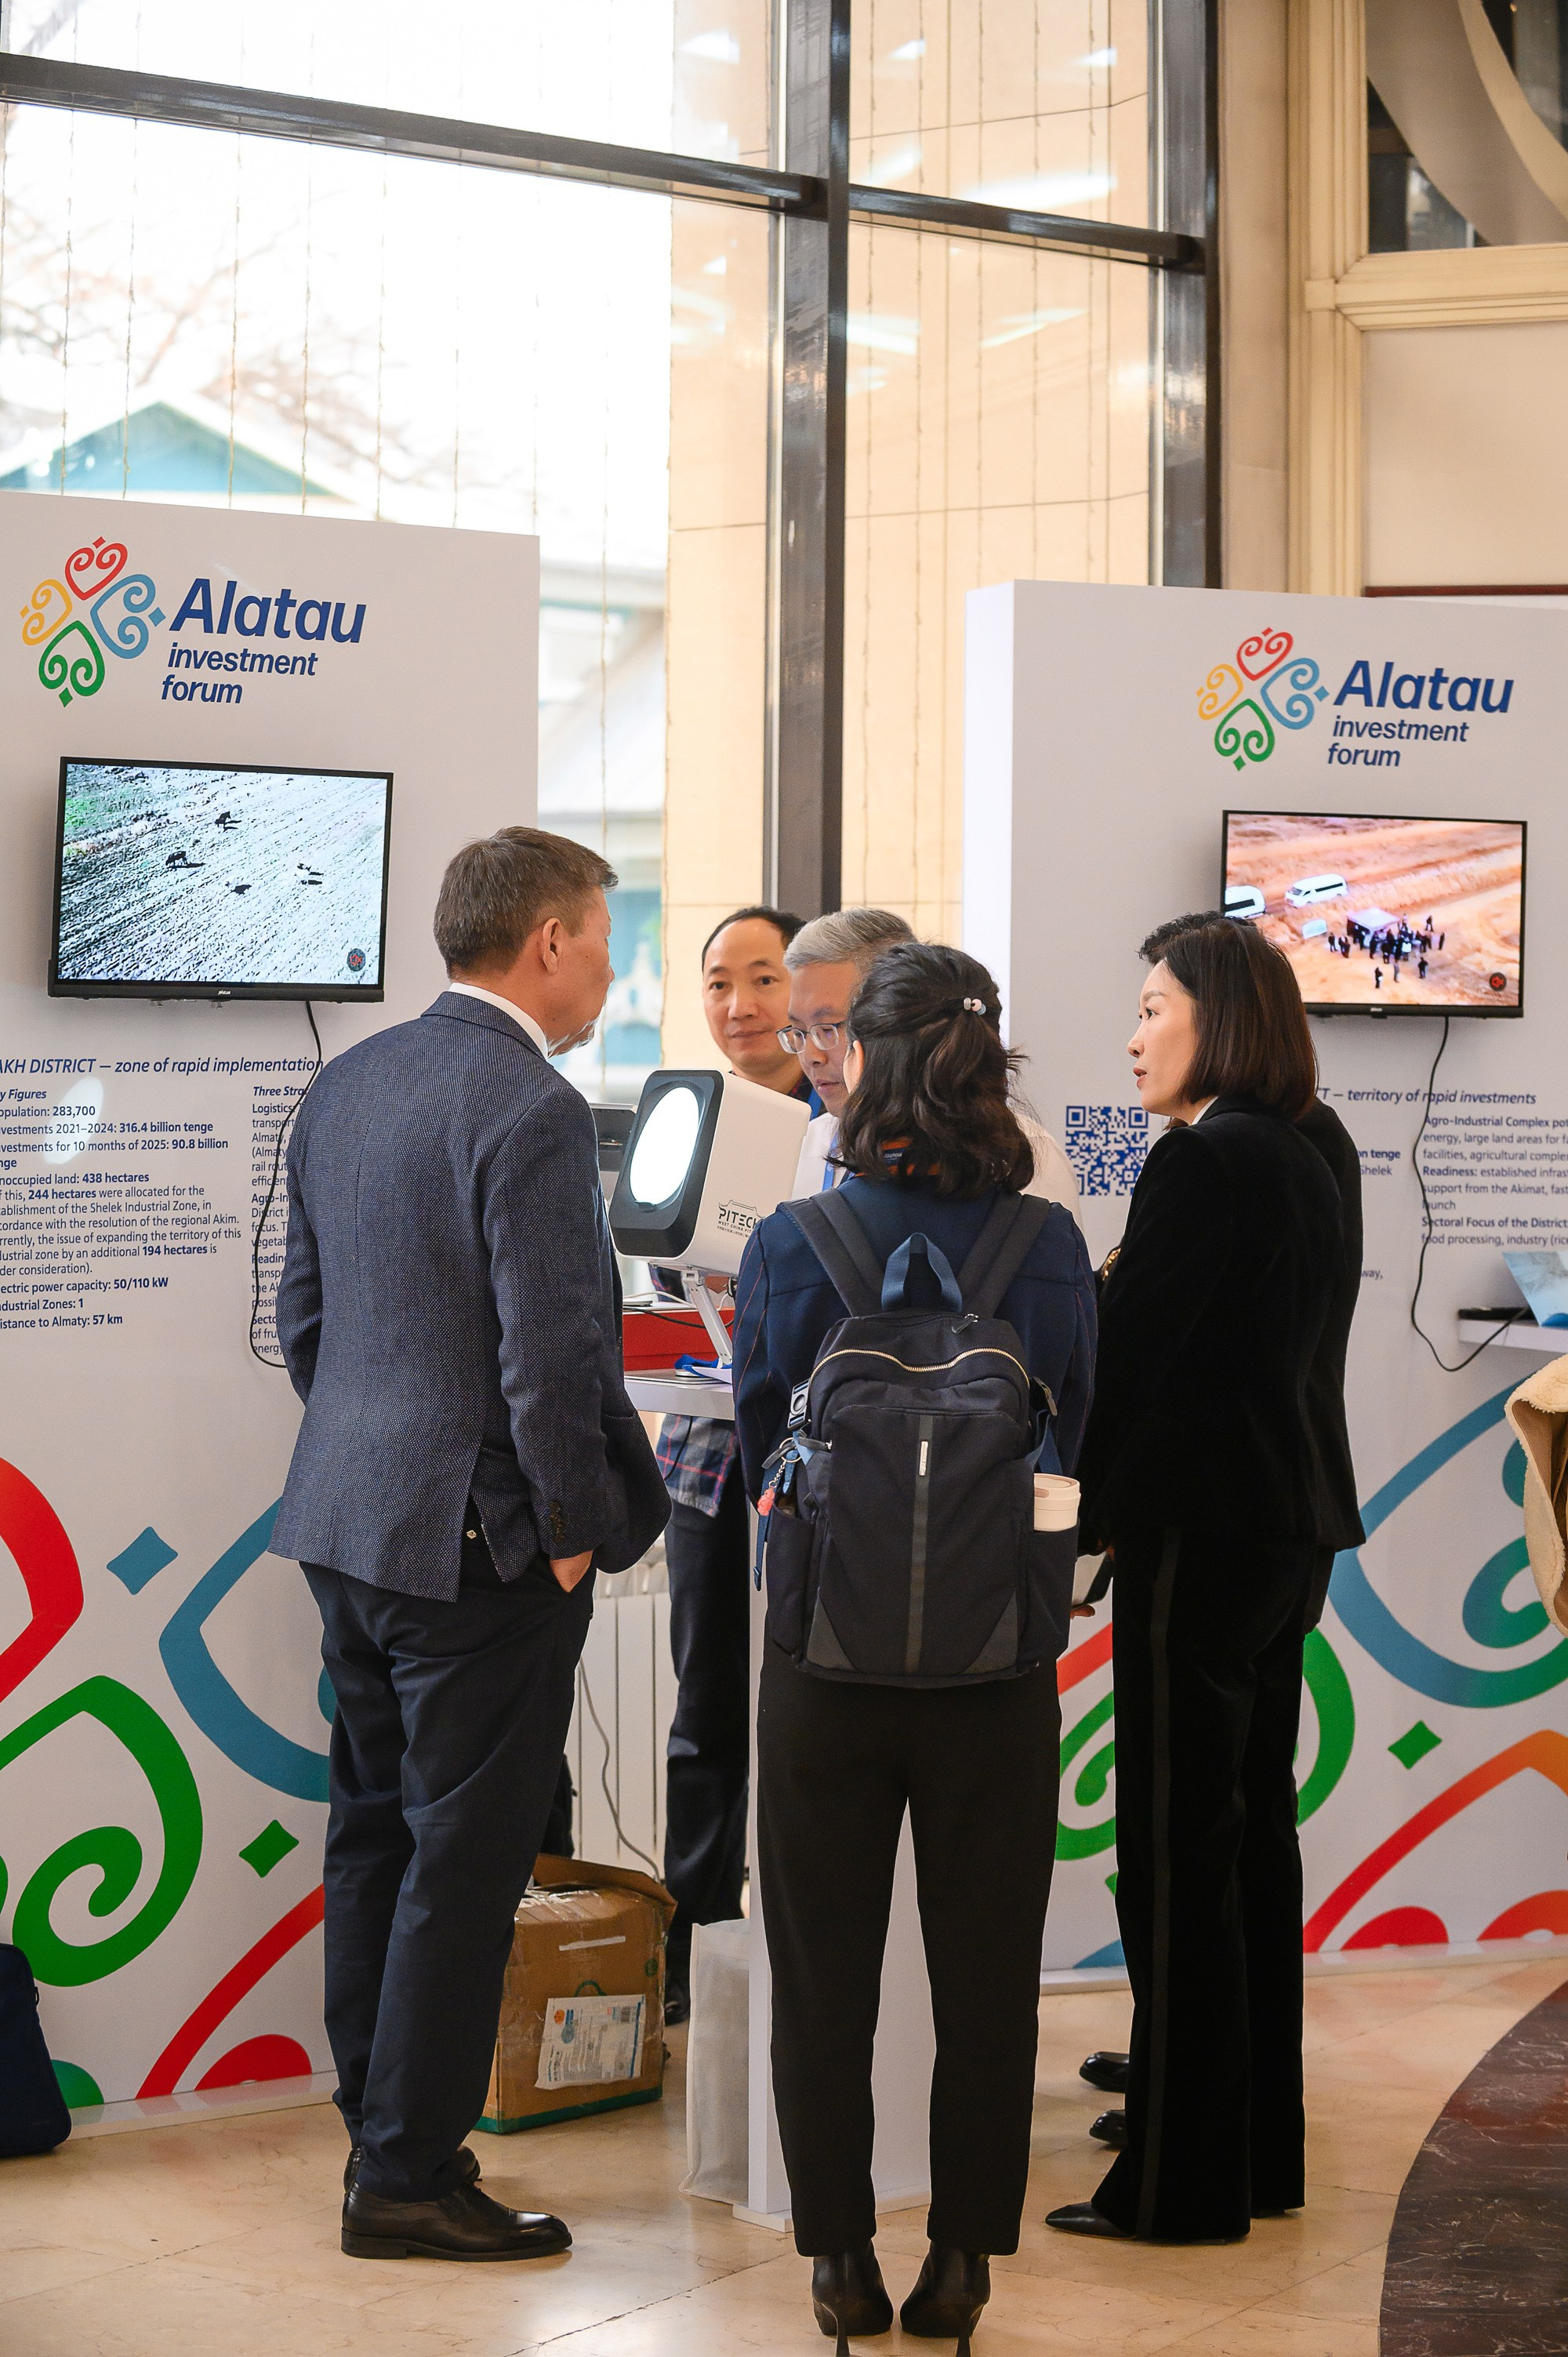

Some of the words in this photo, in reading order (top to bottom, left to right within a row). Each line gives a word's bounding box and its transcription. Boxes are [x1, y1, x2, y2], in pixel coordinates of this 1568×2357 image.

[169, 577, 366, 643] Alatau
[168, 642, 318, 675] investment
[162, 674, 243, 703] forum
[1333, 659, 1514, 714] Alatau
[1333, 715, 1469, 742] investment
[1328, 743, 1400, 767] forum
[29, 1059, 96, 1073] DISTRICT
[114, 1062, 150, 1073] zone
[154, 1057, 169, 1072] of
[172, 1058, 210, 1076] rapid
[213, 1057, 323, 1075] implementation
[9, 1089, 47, 1102] Figures
[253, 1086, 281, 1096] Three
[283, 1086, 307, 1095] Stra
[1348, 1088, 1403, 1105] territory
[1406, 1089, 1421, 1102] of
[1422, 1090, 1457, 1105] rapid
[1460, 1090, 1536, 1104] investments
[53, 1106, 96, 1118] 283,700
[0, 1124, 53, 1135] vestments
[119, 1123, 147, 1132] 316.4
[150, 1122, 180, 1132] billion
[183, 1123, 213, 1133] tenge
[1506, 1117, 1549, 1128] Complex
[0, 1142, 53, 1152] vestments
[56, 1142, 70, 1152] for
[74, 1142, 85, 1151] 10
[88, 1140, 125, 1151] months
[128, 1140, 139, 1150] of
[141, 1139, 169, 1149] 2025:
[172, 1139, 195, 1149] 90.8
[198, 1139, 228, 1149] billion
[1423, 1134, 1461, 1145] energy,
[1465, 1132, 1489, 1146] large
[1492, 1132, 1513, 1143] land
[1517, 1135, 1542, 1144] areas
[1546, 1133, 1559, 1144] for
[252, 1146, 285, 1159] (Almay
[1370, 1149, 1401, 1161] tenge
[1423, 1148, 1467, 1160] facilities,
[1470, 1149, 1526, 1162] agricultural
[1530, 1150, 1568, 1162] comple
[252, 1161, 265, 1171] rail
[1423, 1165, 1477, 1175] Readiness:
[1480, 1167, 1537, 1177] established
[55, 1173, 79, 1184] land:
[82, 1173, 102, 1183] 438
[105, 1172, 149, 1182] hectares
[5, 1189, 26, 1201] this,
[28, 1189, 49, 1200] 244
[52, 1189, 96, 1199] hectares
[125, 1186, 169, 1197] allocated
[172, 1186, 186, 1196] for
[188, 1185, 205, 1195] the
[1465, 1182, 1488, 1193] from
[1491, 1183, 1508, 1193] the
[1511, 1184, 1548, 1195] Akimat,
[0, 1204, 56, 1215] ablishment
[58, 1203, 69, 1213] of
[71, 1203, 88, 1213] the
[90, 1201, 122, 1212] Shelek
[125, 1200, 169, 1211] Industrial
[172, 1200, 200, 1211] Zone,
[203, 1200, 211, 1209] in
[45, 1218, 66, 1229] with
[69, 1218, 85, 1228] the
[89, 1216, 136, 1228] resolution
[140, 1215, 150, 1226] of
[153, 1215, 169, 1226] the
[171, 1214, 210, 1227] regional
[213, 1214, 239, 1224] Akim.
[1422, 1216, 1463, 1227] Sctoral
[1466, 1217, 1495, 1227] Focus
[1497, 1217, 1508, 1227] of
[1511, 1218, 1528, 1227] the
[38, 1234, 54, 1244] the
[56, 1233, 81, 1244] issue
[83, 1233, 94, 1243] of
[96, 1231, 147, 1244] expanding
[151, 1230, 166, 1240] the
[169, 1229, 209, 1241] territory
[212, 1228, 222, 1239] of
[223, 1228, 241, 1239] this
[1448, 1234, 1504, 1247] processing,
[1507, 1234, 1548, 1247] industry
[35, 1251, 58, 1259] zone
[62, 1248, 74, 1261] by
[91, 1247, 140, 1258] additional
[142, 1246, 161, 1255] 194
[164, 1244, 207, 1255] hectares
[210, 1244, 216, 1253] is
[0, 1266, 16, 1275] der
[19, 1262, 93, 1275] consideration).
[32, 1284, 64, 1295] power
[66, 1280, 111, 1293] capacity:
[114, 1277, 149, 1290] 50/110
[152, 1277, 169, 1287] kW
[252, 1284, 267, 1293] te
[0, 1299, 39, 1311] dustrial
[42, 1299, 75, 1309] Zones:
[78, 1298, 83, 1307] 1
[38, 1317, 49, 1327] to
[52, 1316, 89, 1327] Almaty:
[93, 1315, 104, 1324] 57
[107, 1313, 122, 1324] km
[252, 1328, 261, 1338] of
